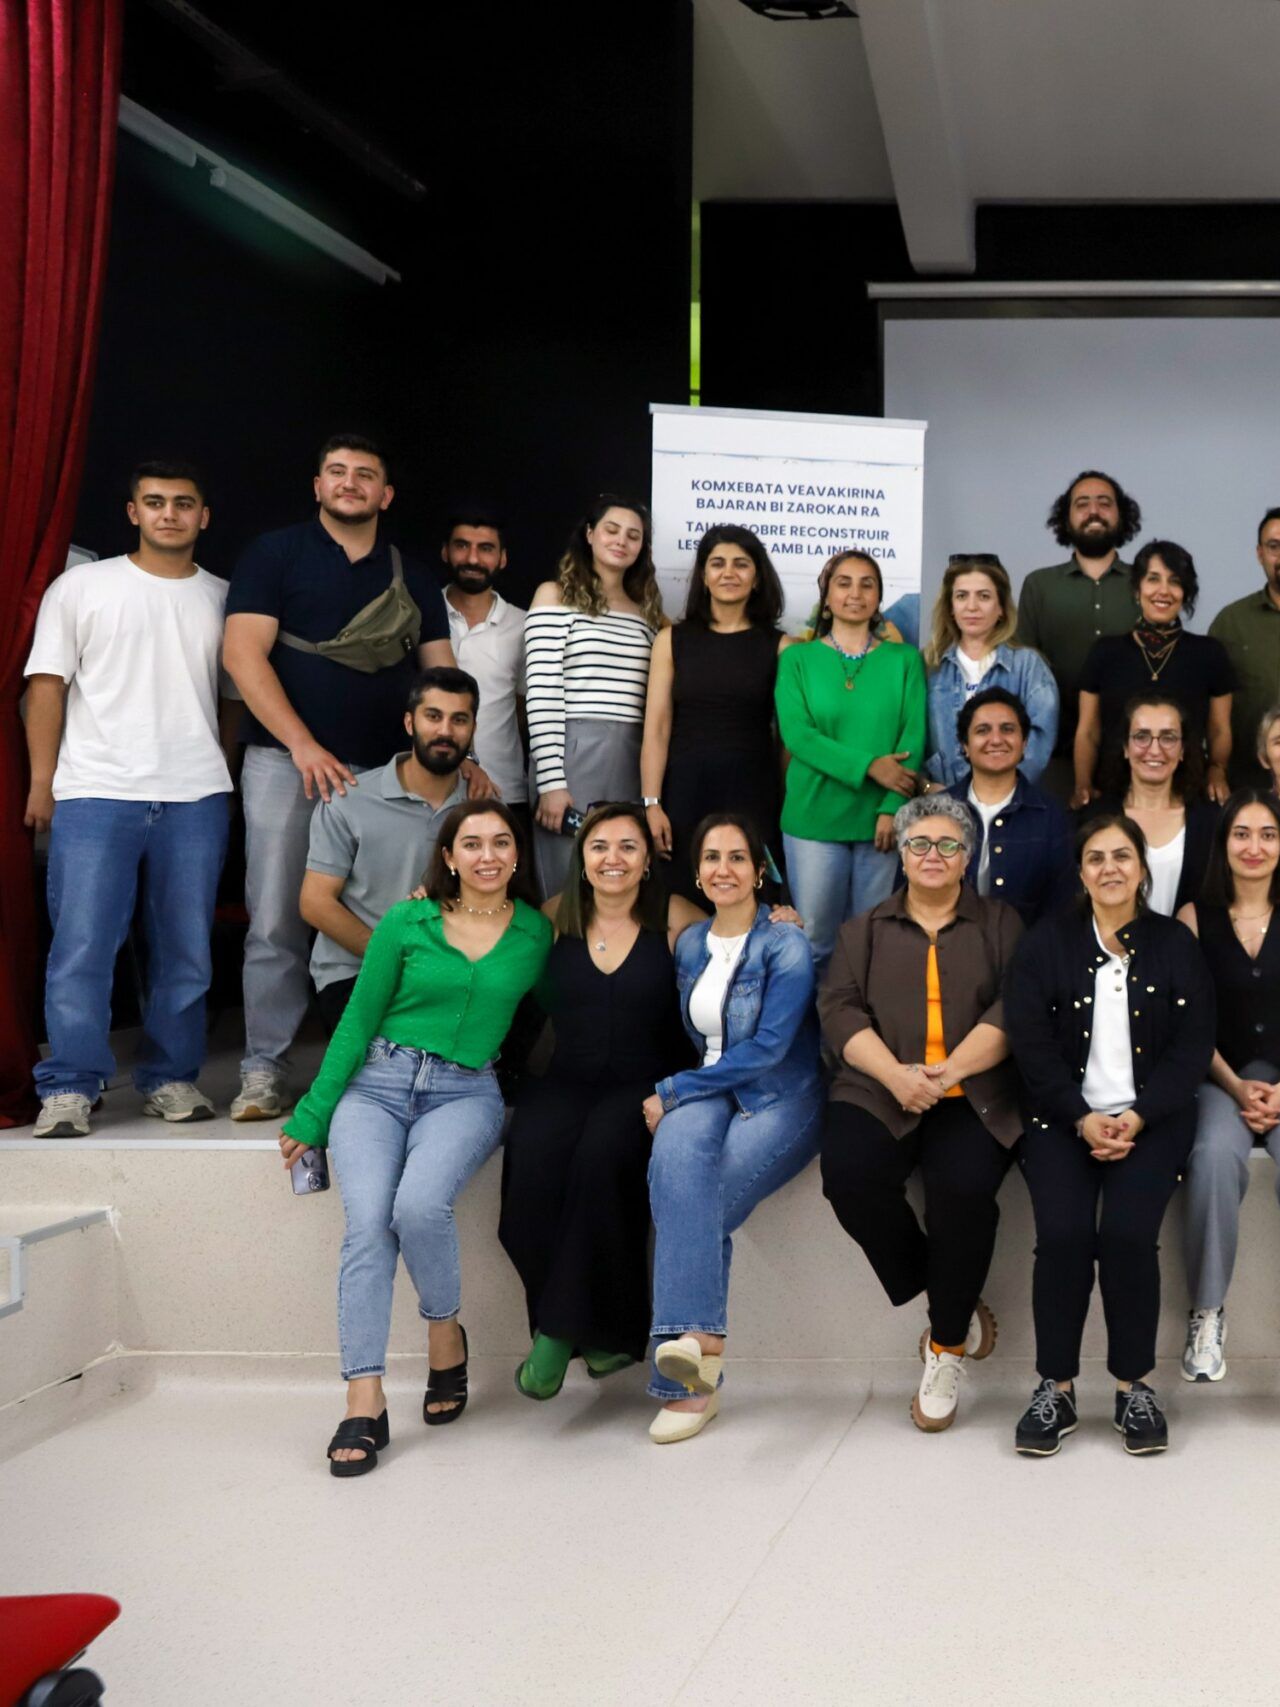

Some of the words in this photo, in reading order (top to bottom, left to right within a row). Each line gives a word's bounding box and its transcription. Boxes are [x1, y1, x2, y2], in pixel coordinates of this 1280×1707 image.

[691, 479, 784, 494] KOMXEBATA
[787, 485, 886, 500] VEAVAKIRINA
[696, 498, 767, 512] BAJARAN
[770, 501, 784, 513] BI
[787, 502, 858, 516] ZAROKAN
[860, 507, 881, 518] RA
[790, 526, 890, 541] RECONSTRUIR
[771, 544, 804, 555] AMB
[806, 546, 824, 556] LA
